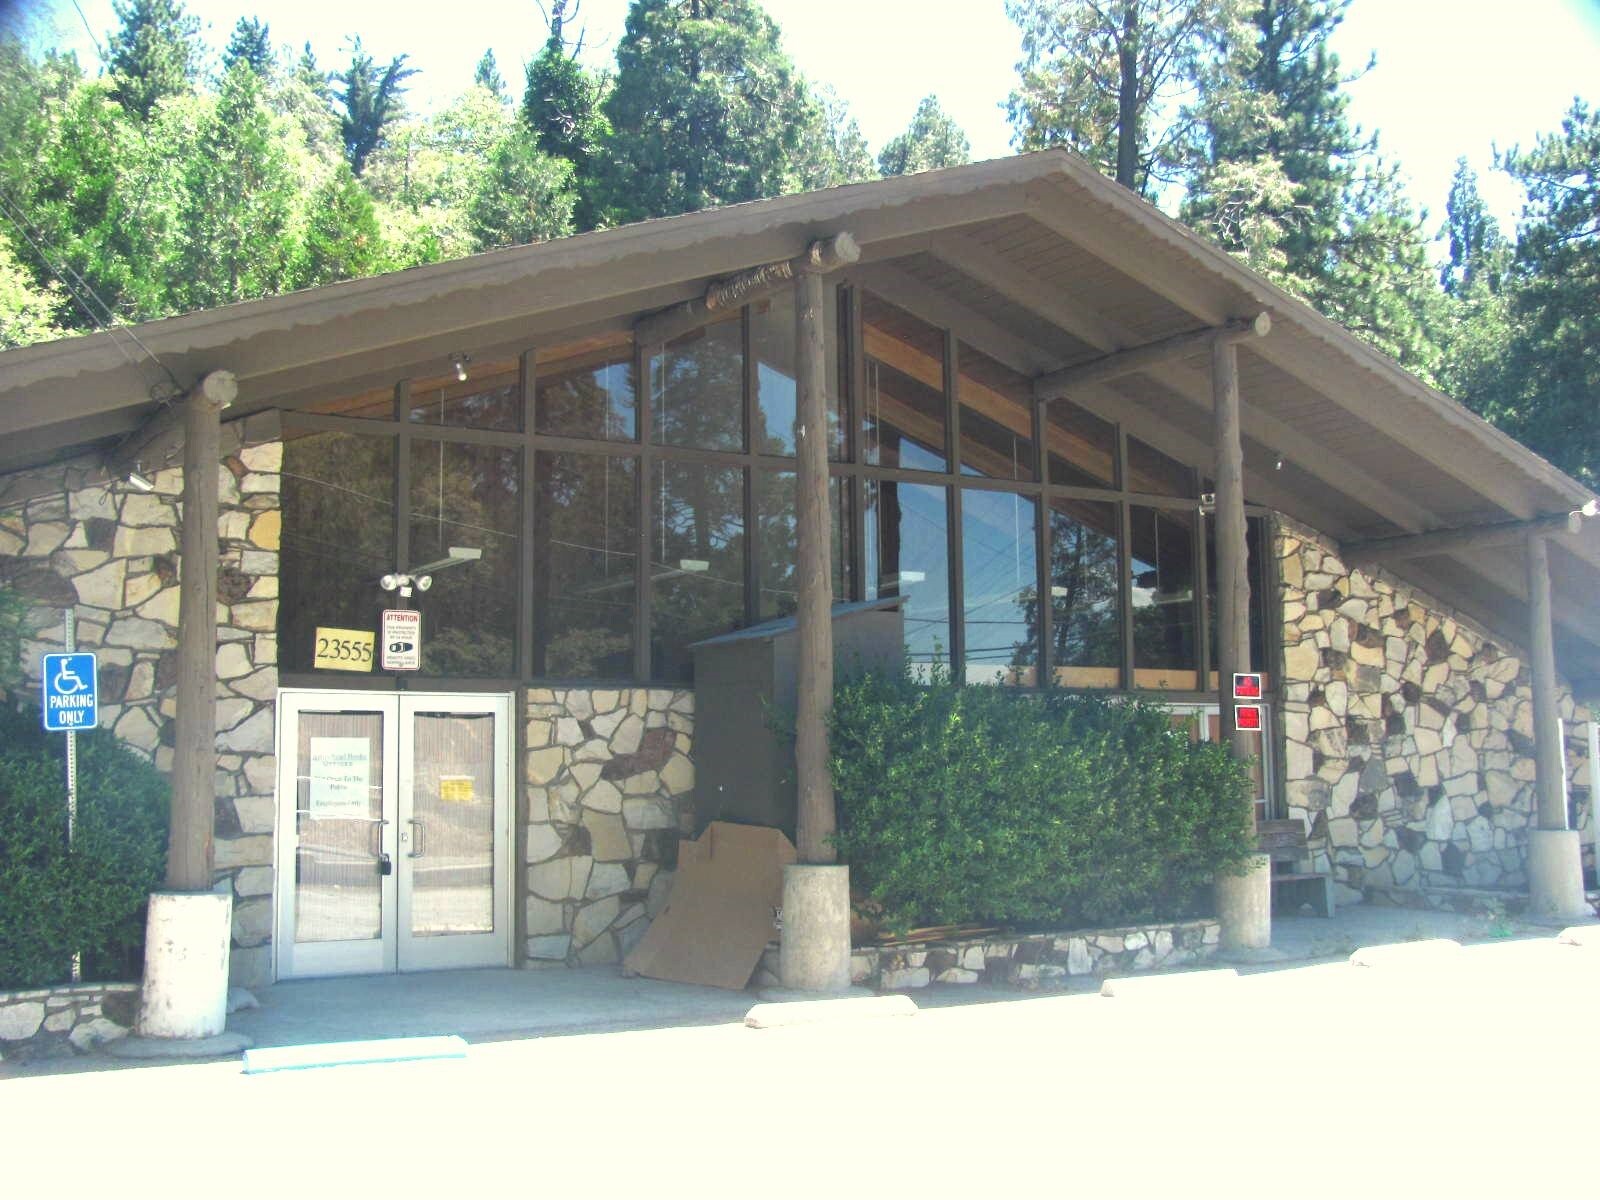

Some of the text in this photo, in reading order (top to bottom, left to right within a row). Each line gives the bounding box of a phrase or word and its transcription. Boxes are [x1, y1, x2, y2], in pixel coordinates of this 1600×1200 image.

[386, 614, 418, 623] ATTENTION
[317, 638, 372, 662] 23555
[50, 694, 93, 708] PARKING
[59, 710, 84, 724] ONLY
